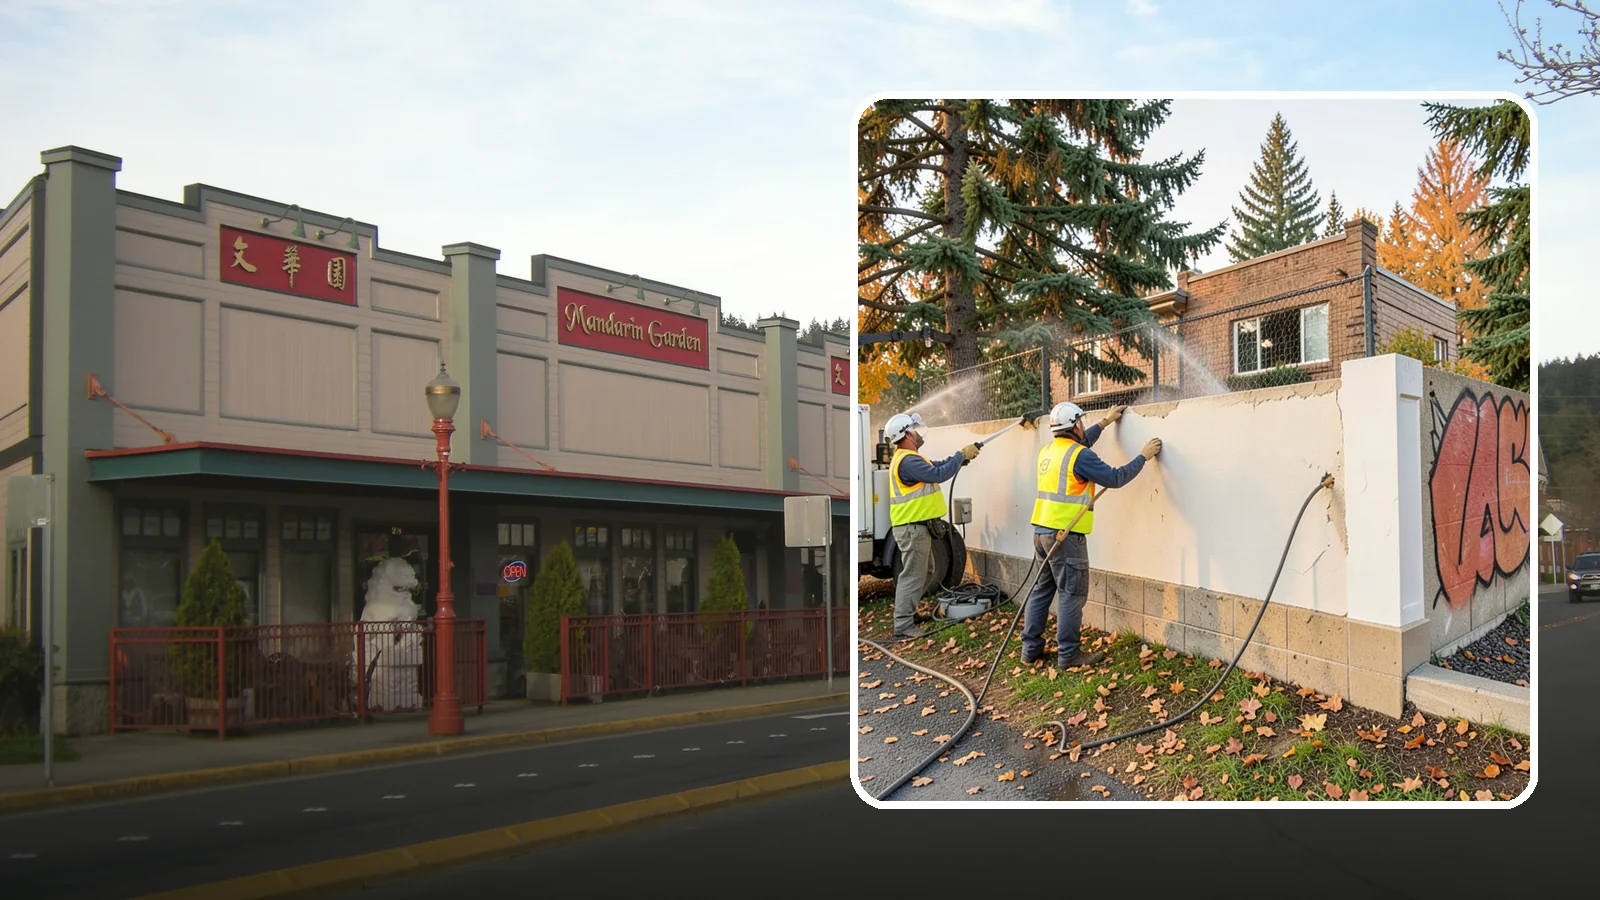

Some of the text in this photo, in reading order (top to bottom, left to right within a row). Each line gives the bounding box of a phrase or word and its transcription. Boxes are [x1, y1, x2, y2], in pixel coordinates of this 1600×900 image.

[230, 236, 347, 290] 文華園
[564, 302, 701, 352] Mandarin Garden
[503, 565, 527, 578] OPEN
